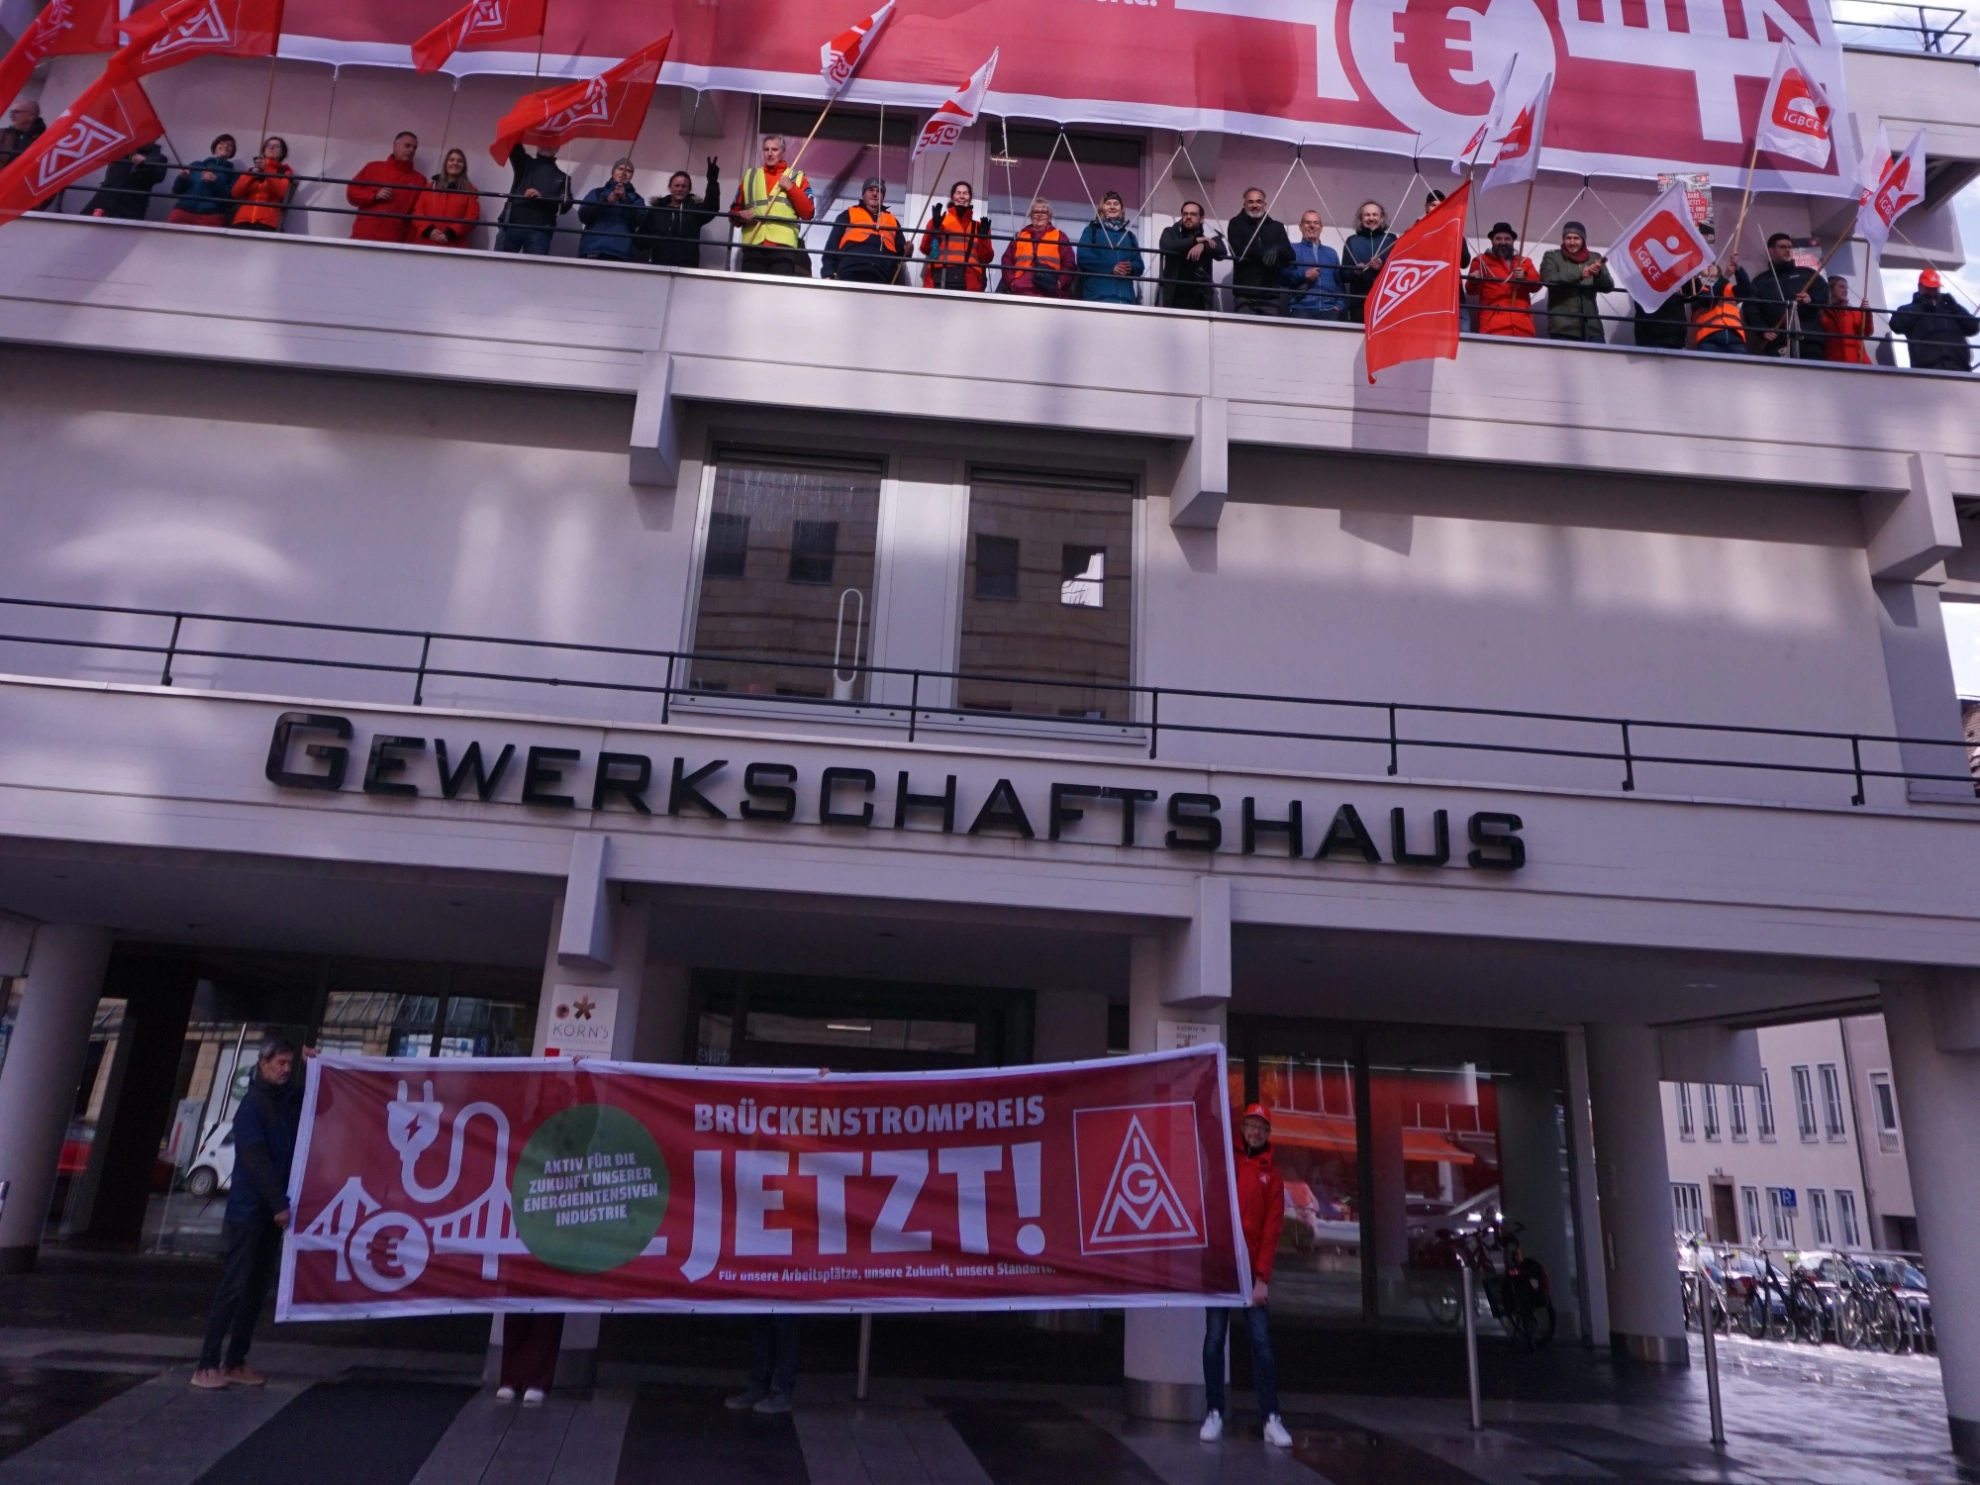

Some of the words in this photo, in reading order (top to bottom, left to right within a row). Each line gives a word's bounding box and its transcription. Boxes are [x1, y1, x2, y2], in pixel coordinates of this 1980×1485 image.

[1783, 111, 1821, 132] IGBCE
[1636, 246, 1661, 281] IGBCE
[265, 712, 1526, 870] GEWERKSCHAFTSHAUS
[553, 1023, 609, 1039] KORN'S
[694, 1095, 1045, 1136] BRÜCKENSTROMPREIS
[544, 1156, 584, 1175] AKTIV
[587, 1152, 612, 1170] FÜR
[615, 1152, 637, 1167] DIE
[529, 1174, 590, 1195] ZUKUNFT
[592, 1167, 652, 1186] UNSERER
[523, 1183, 658, 1213] ENERGIEINTENSIVEN
[680, 1141, 1046, 1282] JETZT!
[556, 1205, 627, 1227] INDUSTRIE
[718, 1271, 737, 1282] Für
[740, 1271, 779, 1282] unsere
[782, 1267, 861, 1284] Arbeitsplätze,
[864, 1266, 903, 1279] unsere
[905, 1264, 954, 1279] Zukunft,
[956, 1264, 994, 1277] unsere
